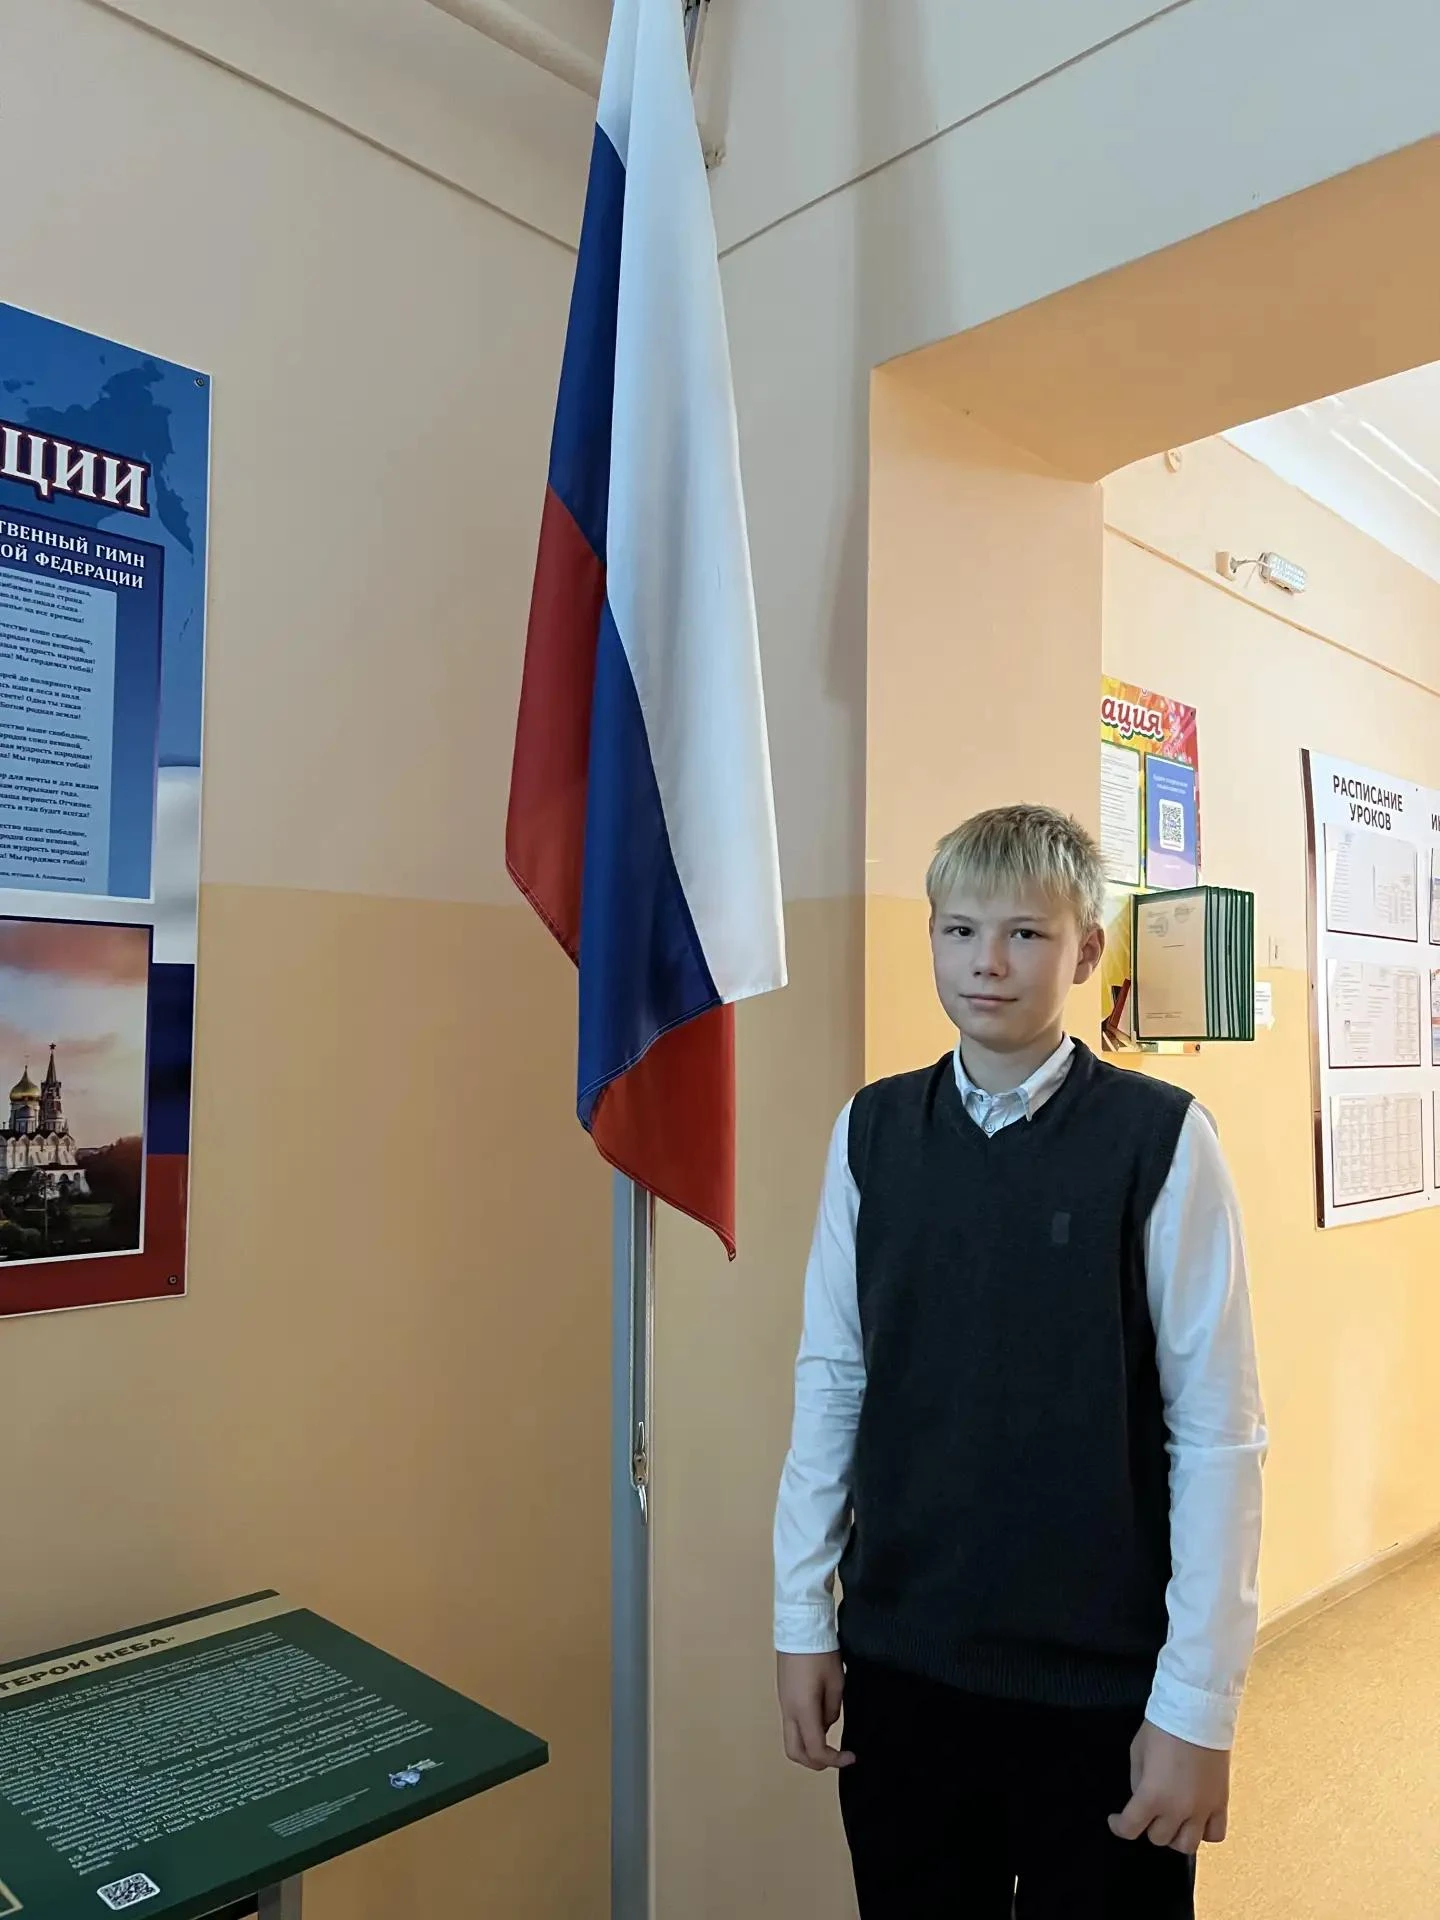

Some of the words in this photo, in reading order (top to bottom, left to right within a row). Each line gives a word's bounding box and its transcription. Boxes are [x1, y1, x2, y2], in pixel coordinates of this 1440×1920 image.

[1, 426, 145, 511] ЦИИ
[34, 552, 143, 589] ФЕДЕРАЦИИ
[95, 544, 145, 568] ГИМН
[1101, 698, 1161, 735] ация
[1333, 775, 1403, 812] РАСПИСАНИЕ
[1350, 803, 1391, 830] УРОКОВ
